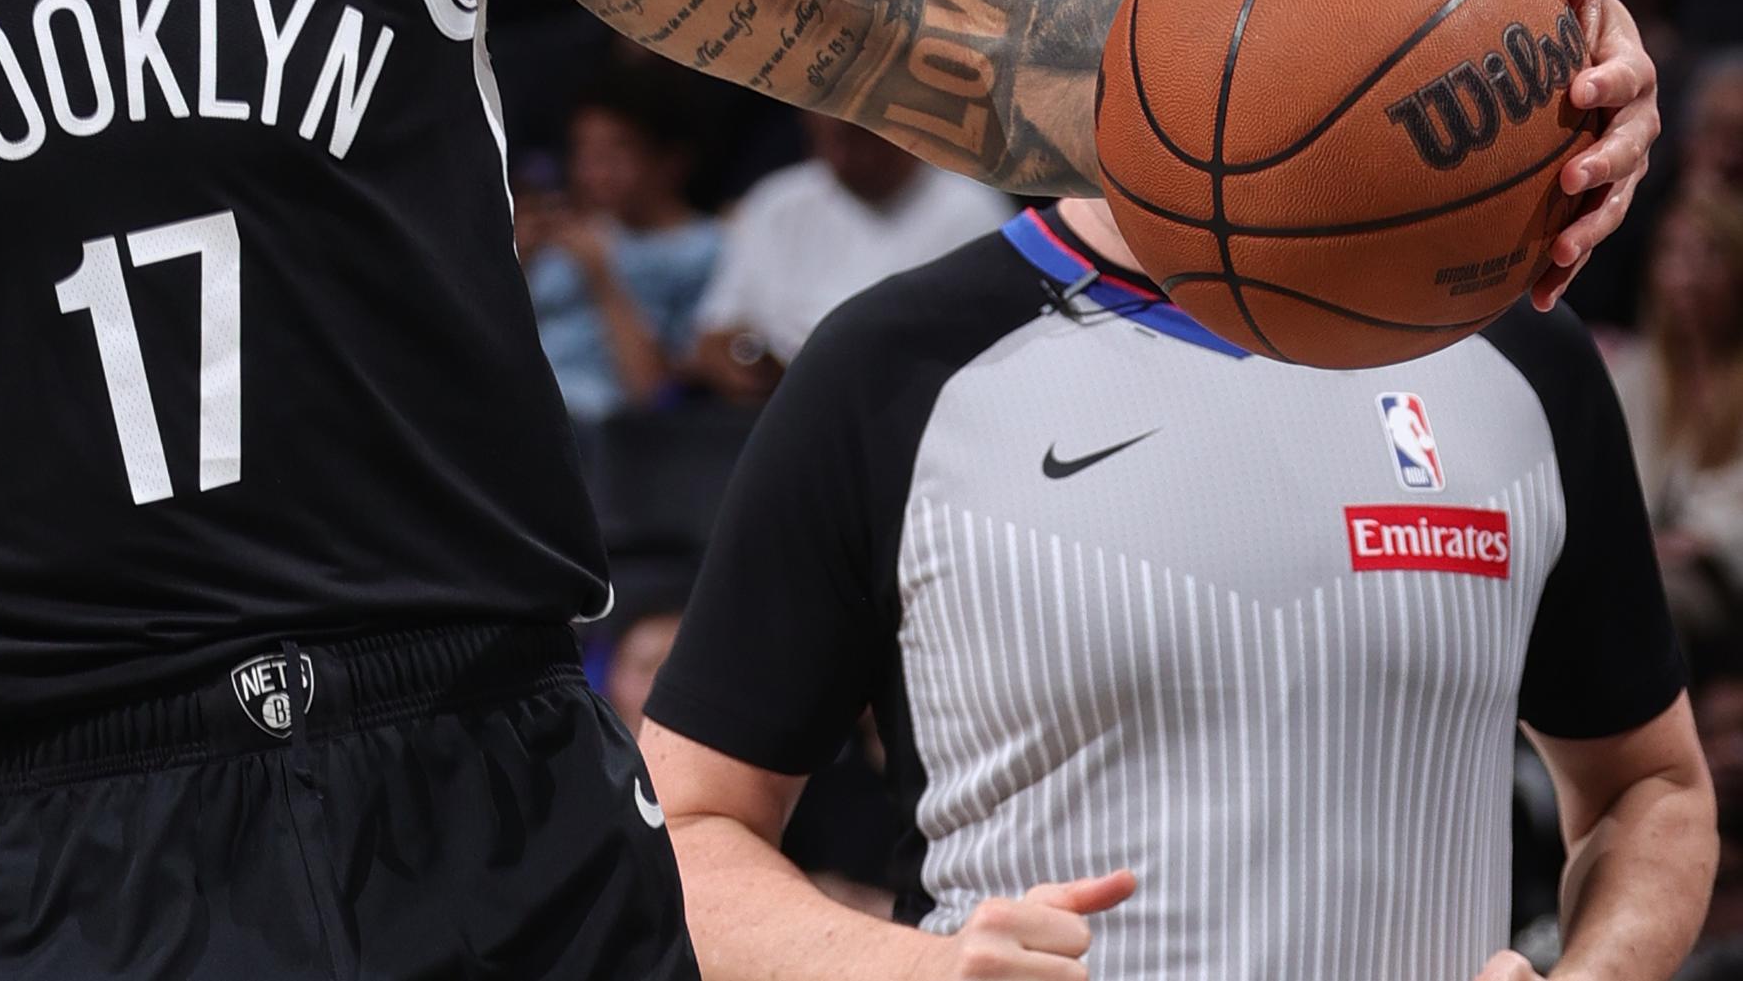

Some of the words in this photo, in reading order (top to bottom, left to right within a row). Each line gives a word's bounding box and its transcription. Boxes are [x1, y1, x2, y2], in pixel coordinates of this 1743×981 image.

[54, 209, 241, 505] 17
[1405, 466, 1430, 484] NBA
[1352, 517, 1508, 563] Emirates
[240, 660, 308, 702] NET
